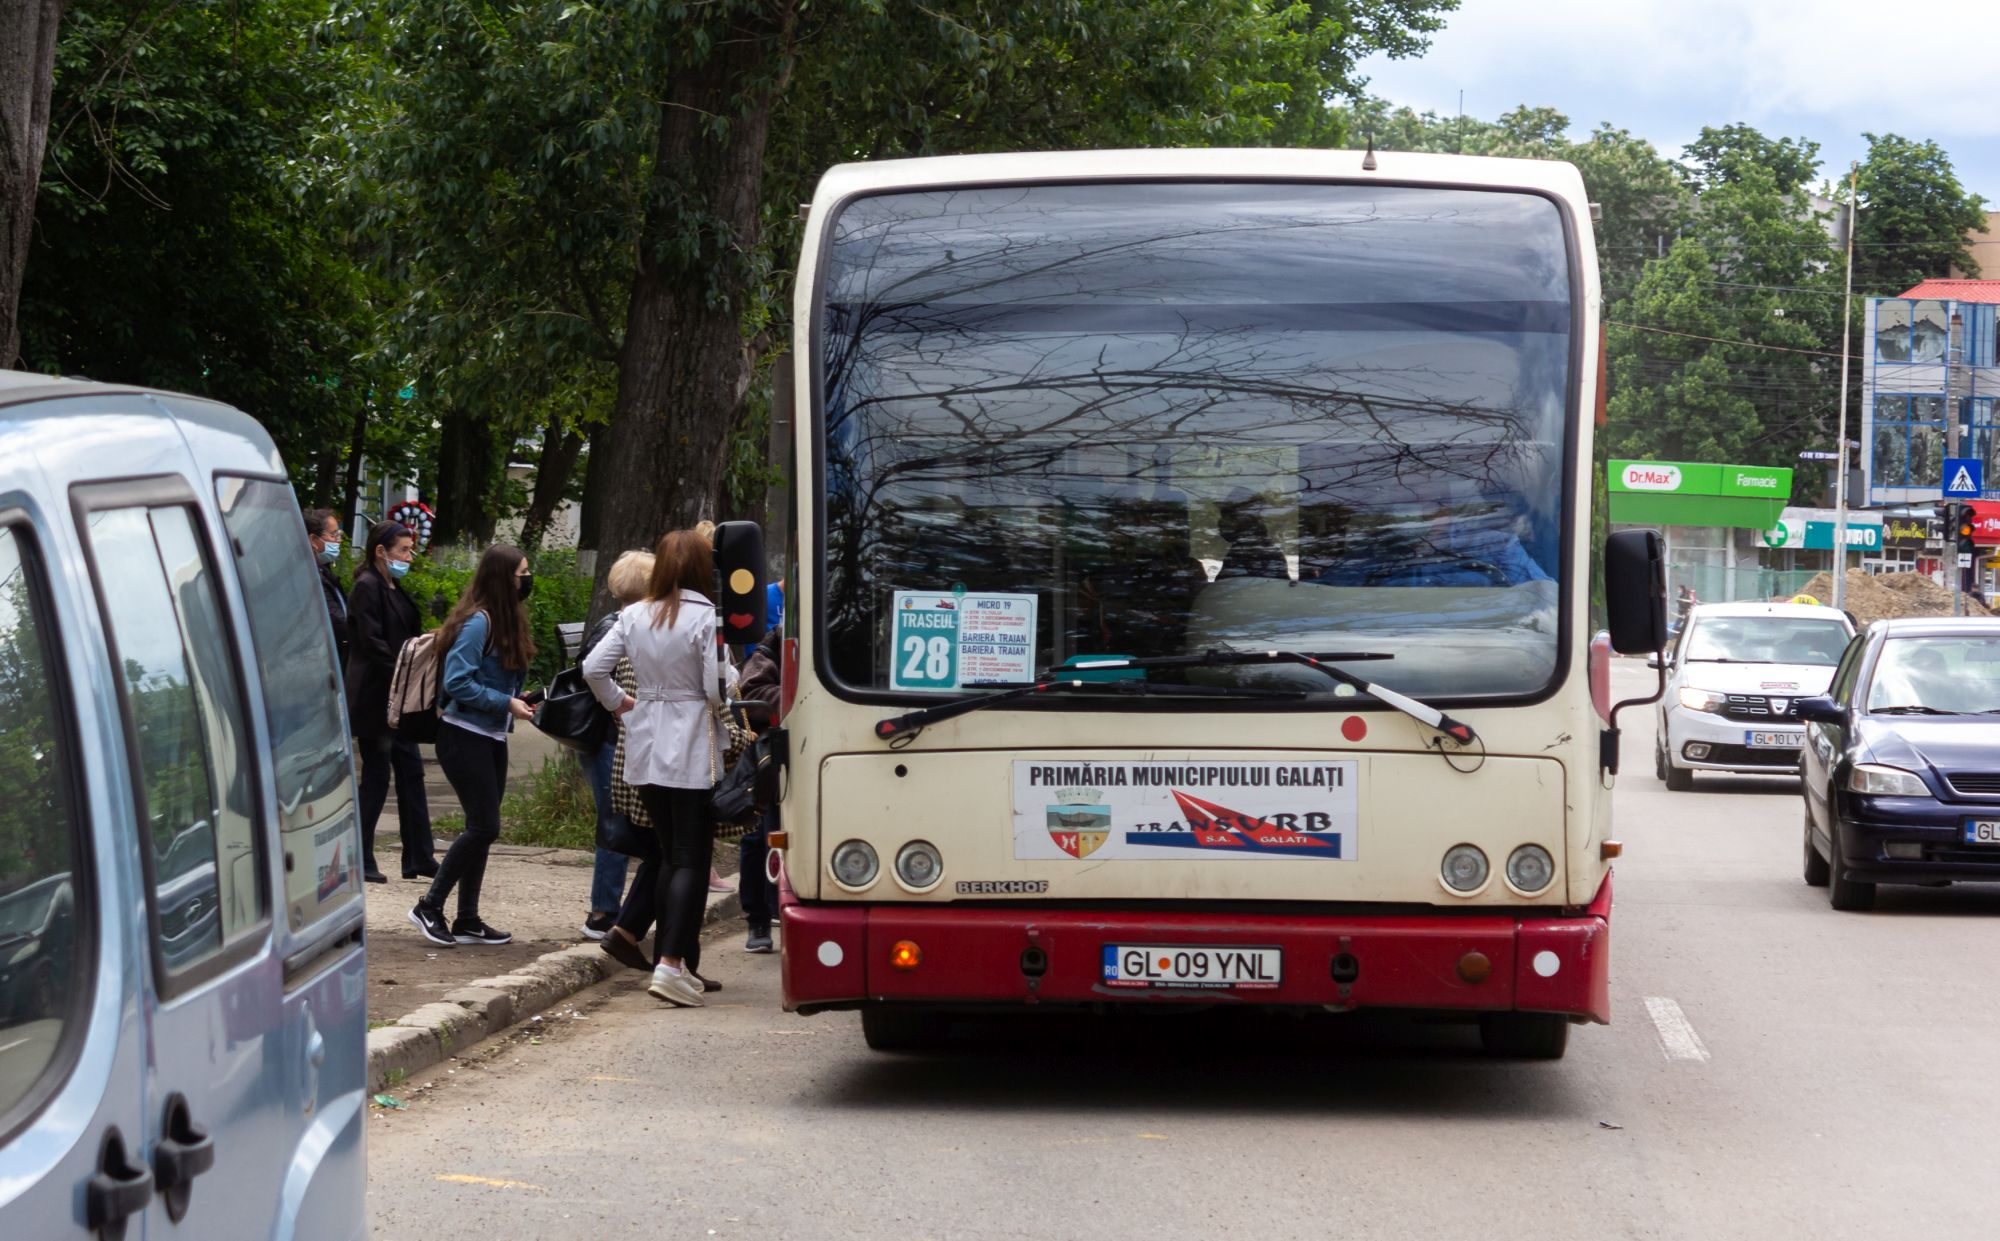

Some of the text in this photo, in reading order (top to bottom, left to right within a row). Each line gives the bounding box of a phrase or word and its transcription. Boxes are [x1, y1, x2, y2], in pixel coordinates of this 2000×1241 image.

[1629, 471, 1670, 484] Dr.Max
[1736, 473, 1777, 488] Farmacie
[977, 600, 1012, 610] MICRO 19
[902, 613, 955, 629] TRASEUL
[962, 632, 1027, 644] BARIERA TRAIAN
[902, 635, 950, 680] 28
[961, 645, 1026, 656] BARIERA TRAIAN
[1754, 733, 1770, 745] GL
[1774, 734, 1785, 745] 10
[1030, 762, 1344, 793] PRIMĂRIA MUNICIPIULUI GALAȚI
[1134, 811, 1333, 833] TRANSURB
[1205, 835, 1231, 843] S.A.
[1977, 823, 2000, 841] GL
[956, 881, 1049, 894] BERKHOF
[1105, 950, 1275, 980] RO GL 09 YNL
